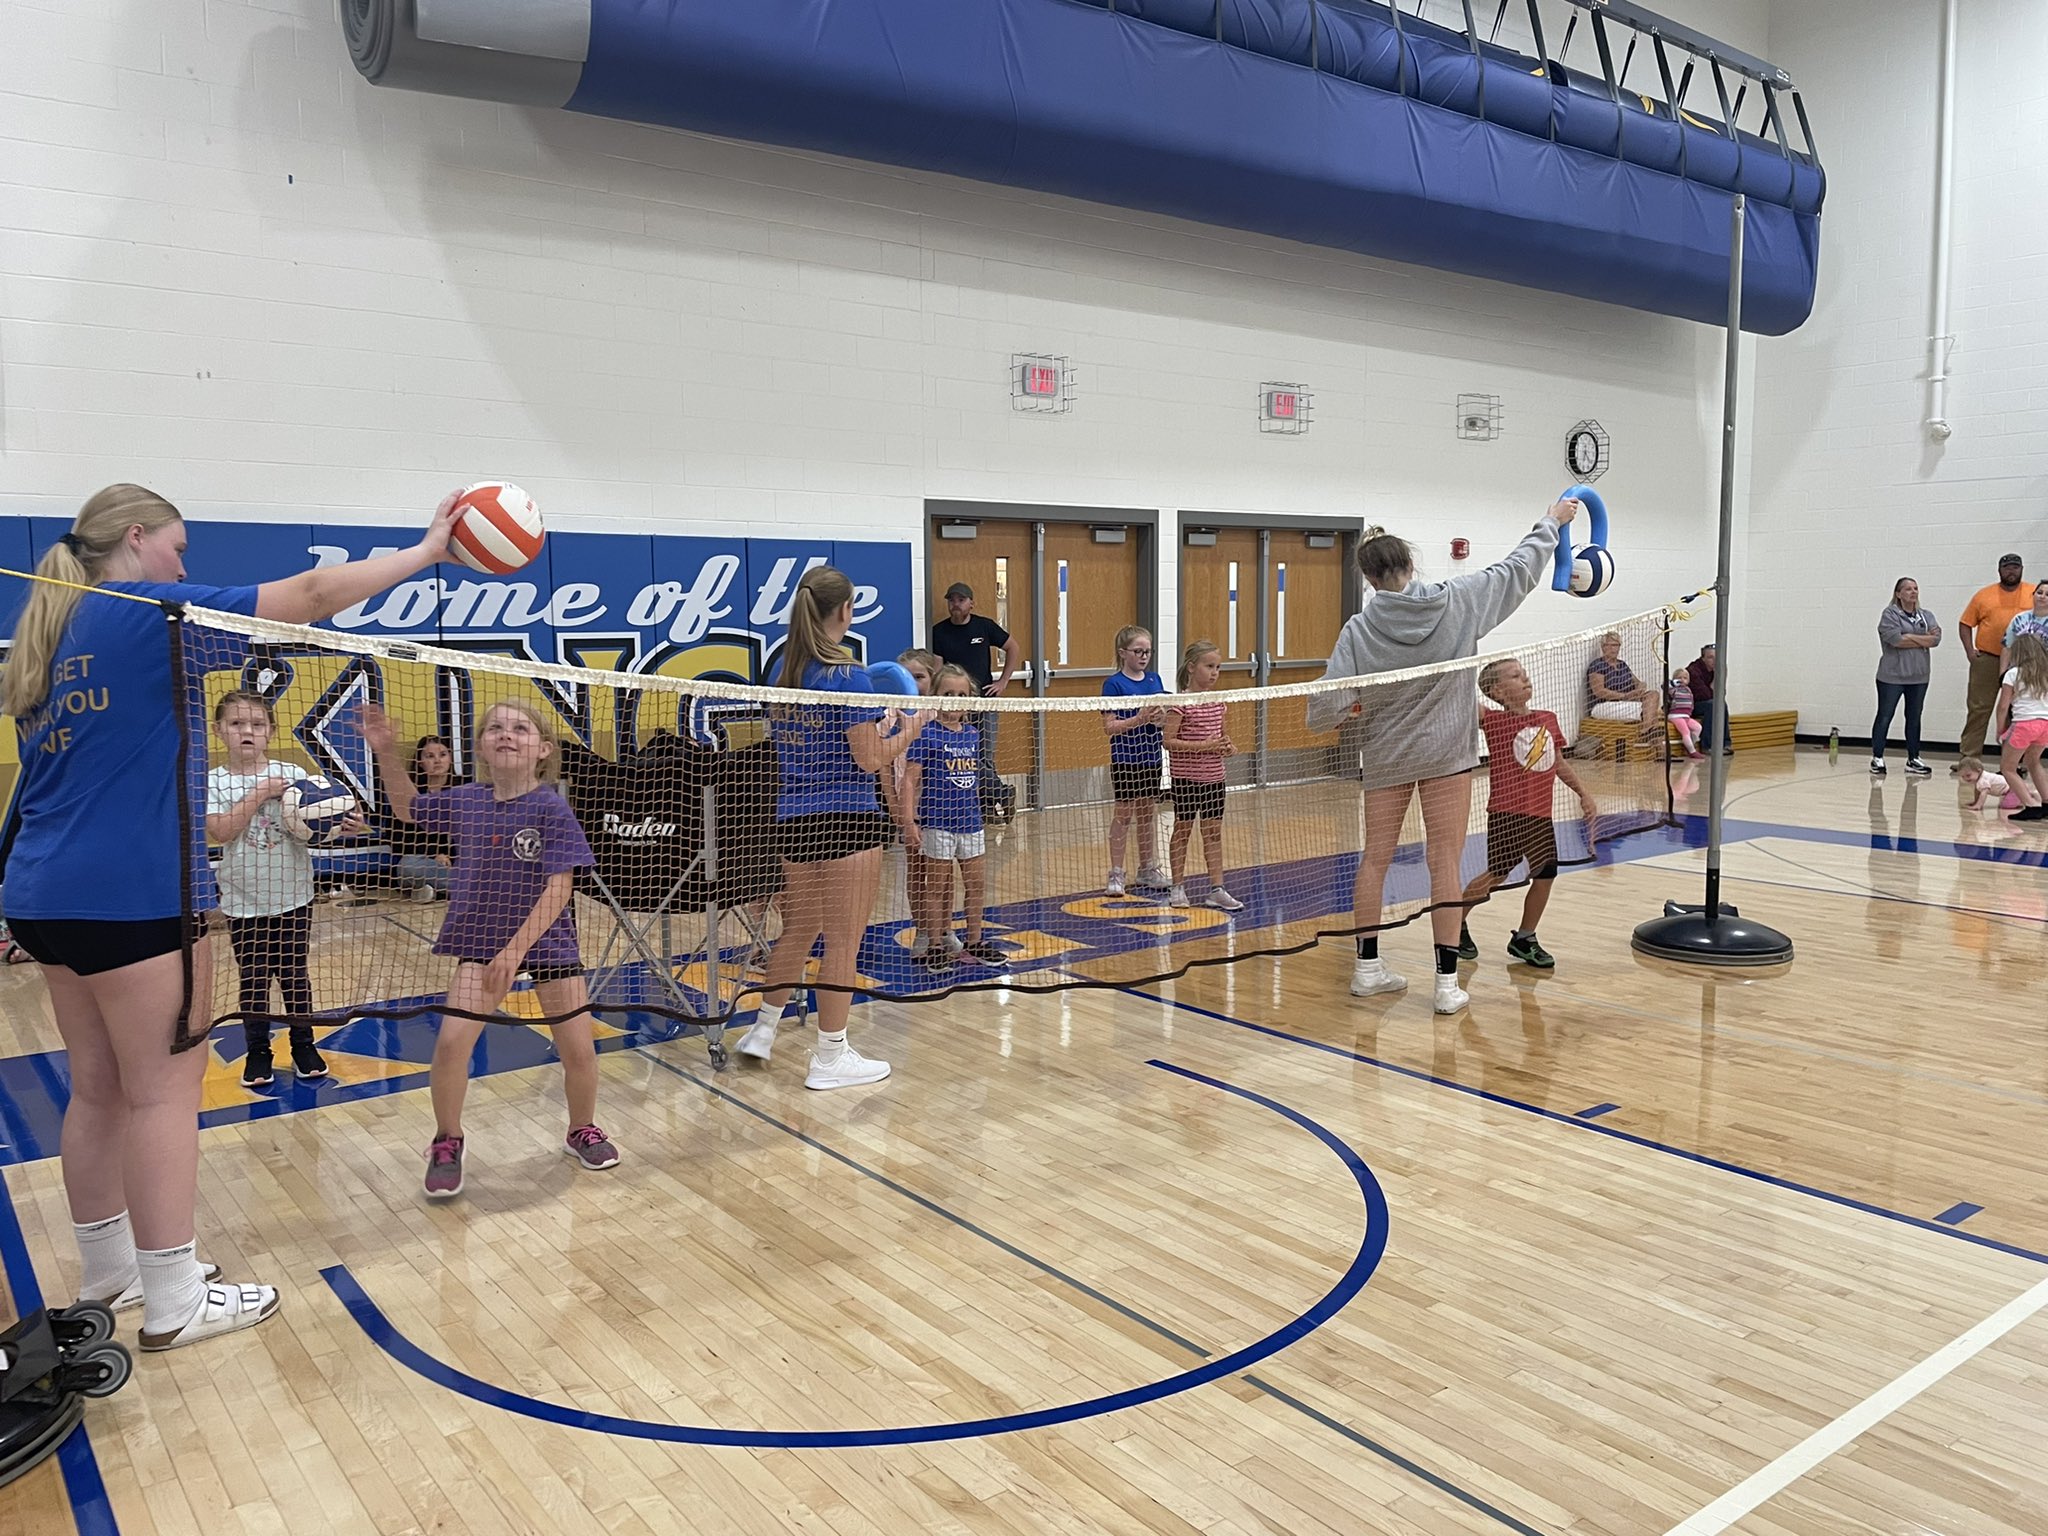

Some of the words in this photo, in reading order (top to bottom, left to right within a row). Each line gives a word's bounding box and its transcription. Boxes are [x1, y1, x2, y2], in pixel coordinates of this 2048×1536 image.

[1030, 367, 1055, 394] EXIT
[1275, 393, 1296, 416] EXIT
[626, 554, 741, 643] of
[53, 654, 95, 686] GET
[56, 687, 110, 716] YOU
[603, 813, 677, 838] Baden
